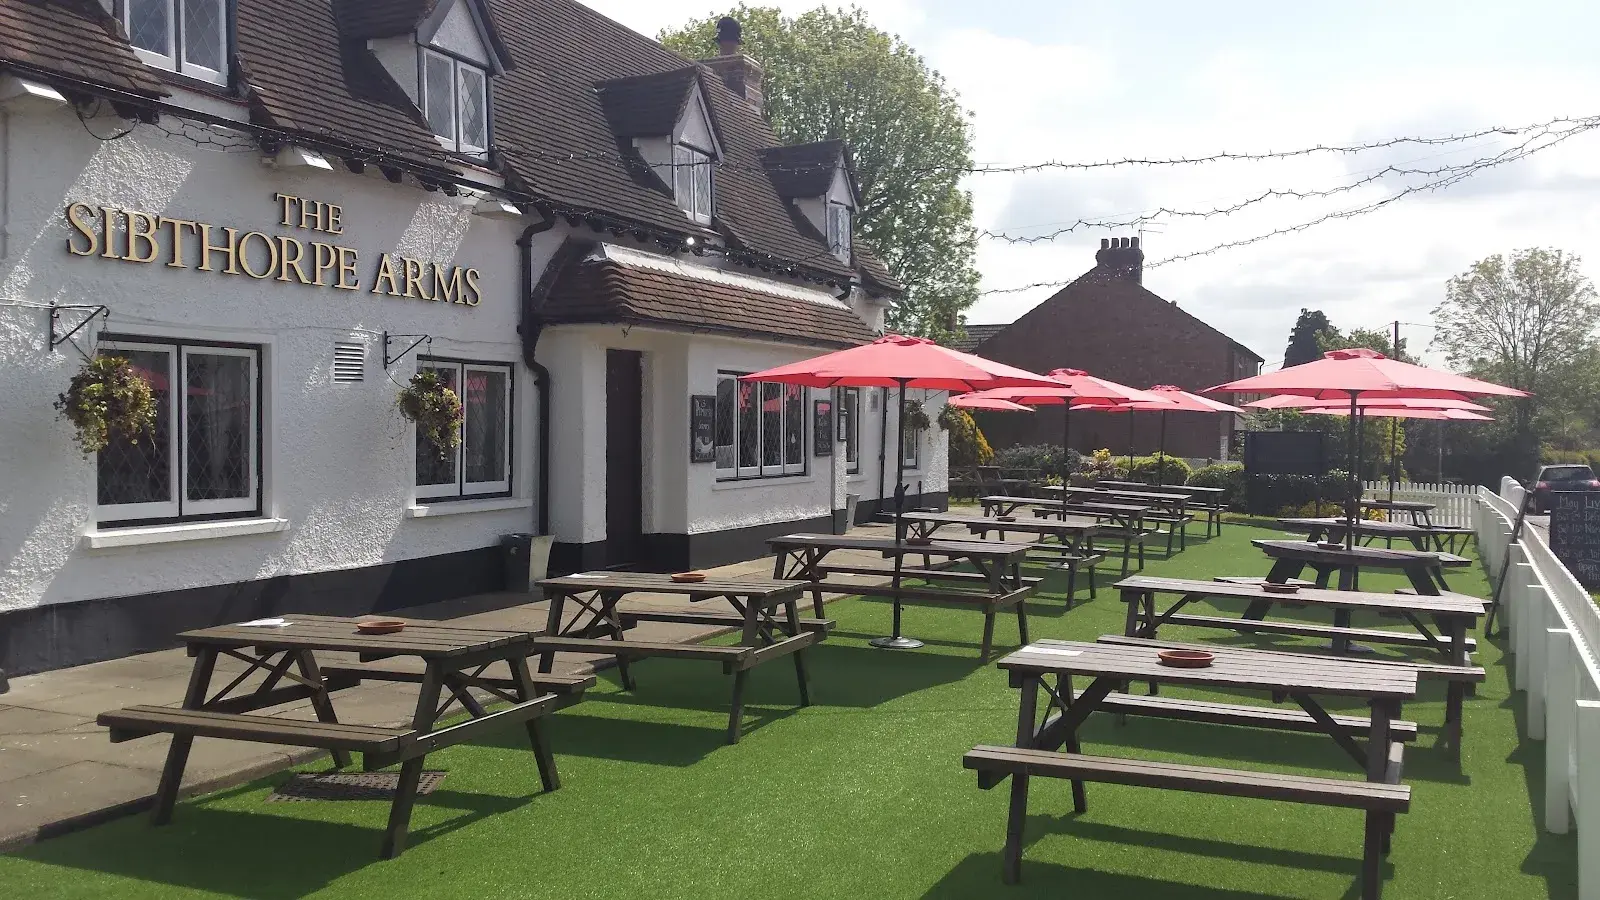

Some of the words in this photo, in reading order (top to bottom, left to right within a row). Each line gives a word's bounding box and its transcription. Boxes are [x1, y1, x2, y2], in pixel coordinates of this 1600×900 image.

[273, 192, 344, 235] THE
[66, 202, 361, 291] SIBTHORPE
[369, 252, 483, 307] ARMS
